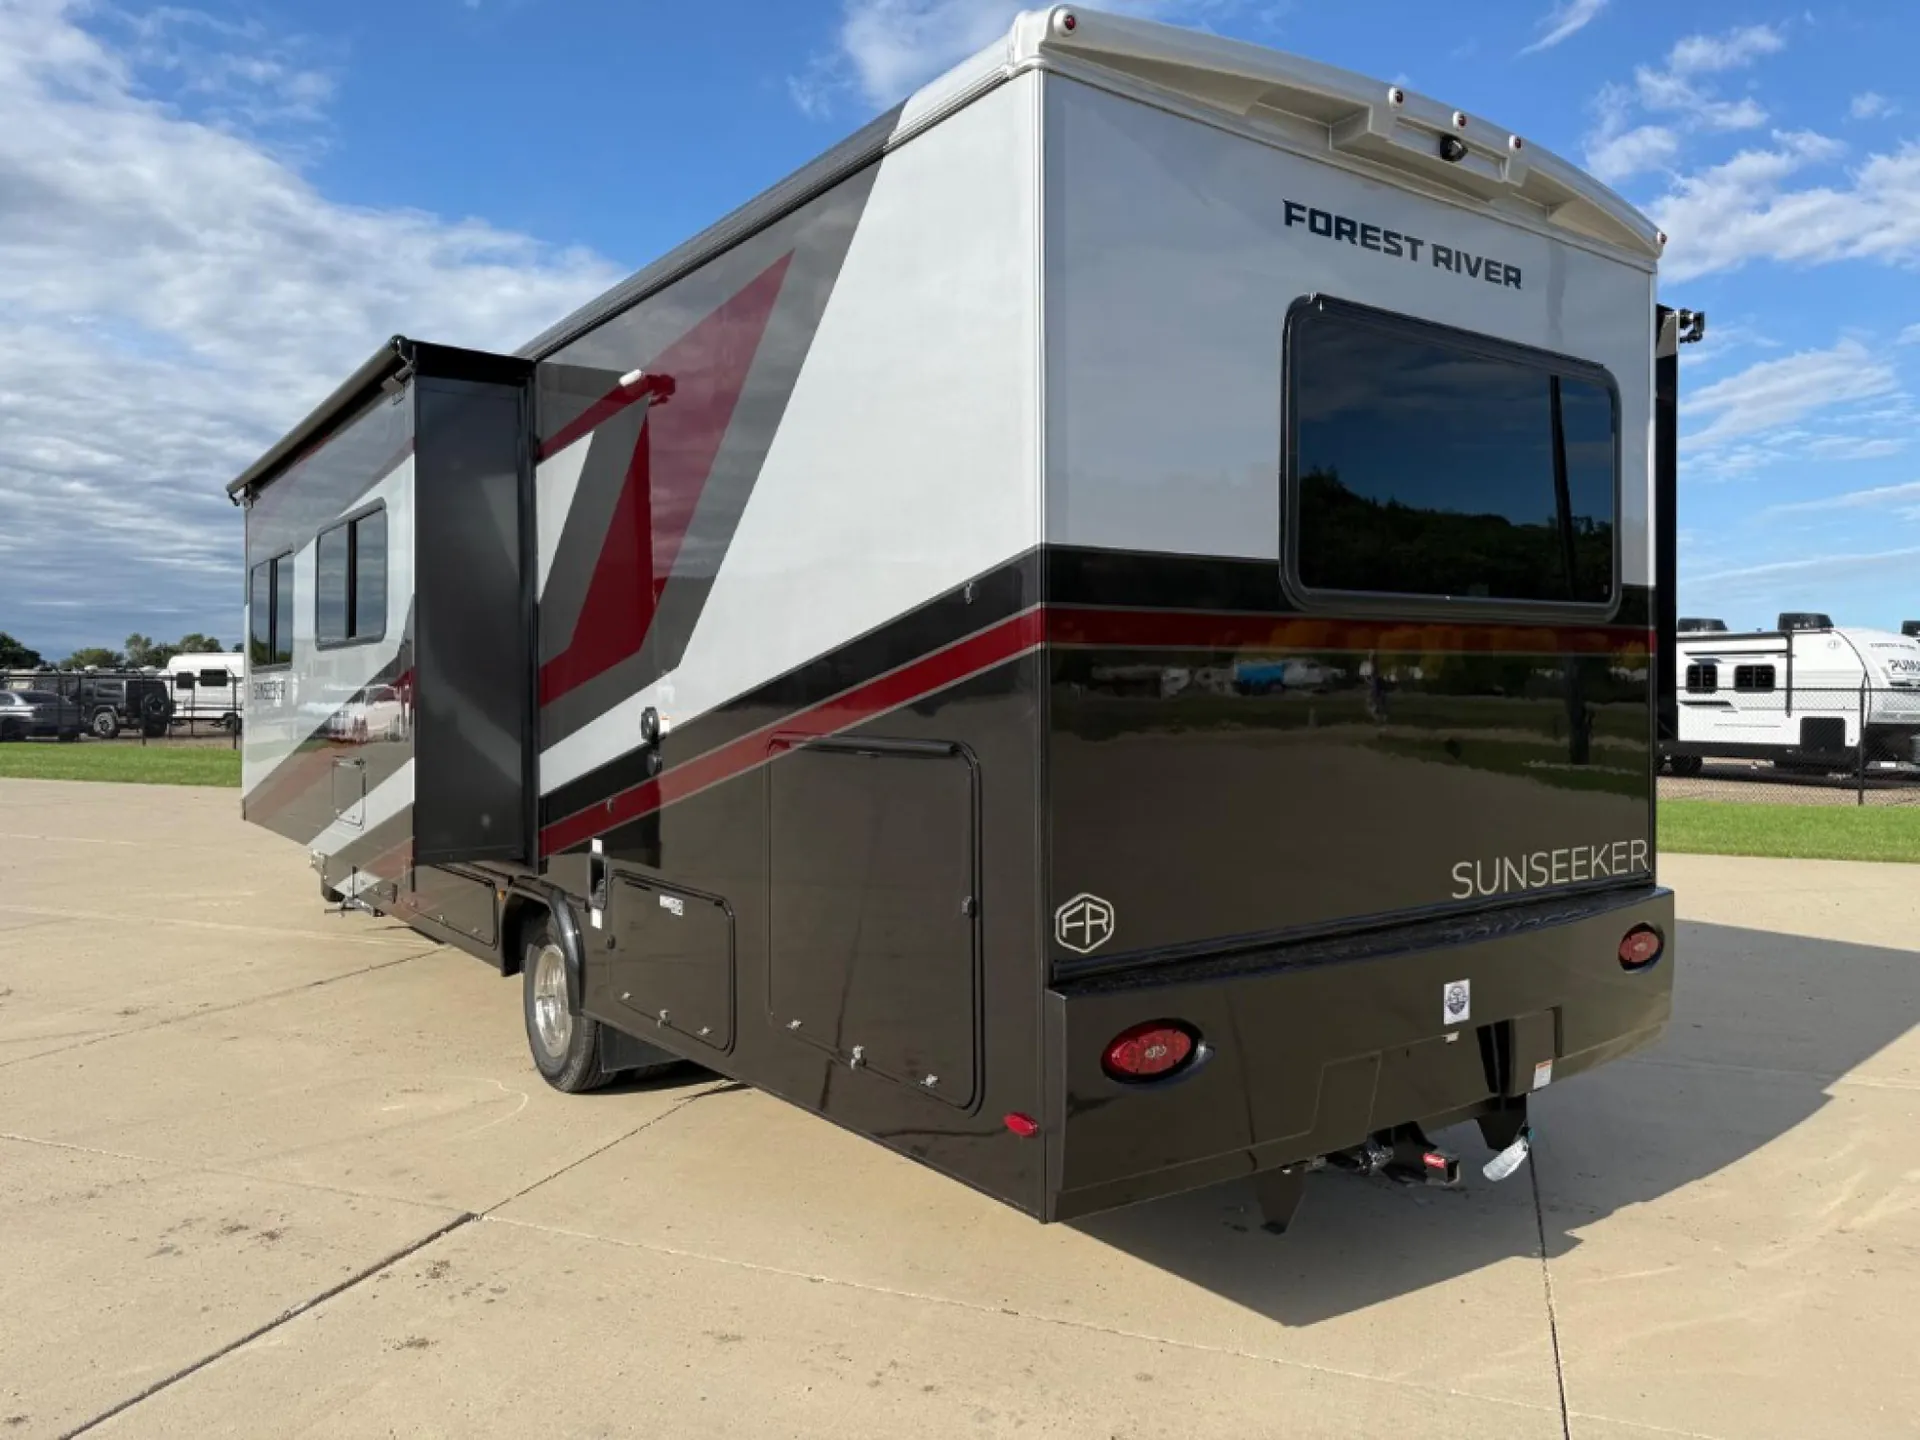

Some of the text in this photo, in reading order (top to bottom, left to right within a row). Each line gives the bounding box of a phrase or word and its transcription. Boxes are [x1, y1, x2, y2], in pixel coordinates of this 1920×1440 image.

[1283, 199, 1522, 290] FOREST RIVER
[1451, 839, 1650, 899] SUNSEEKER
